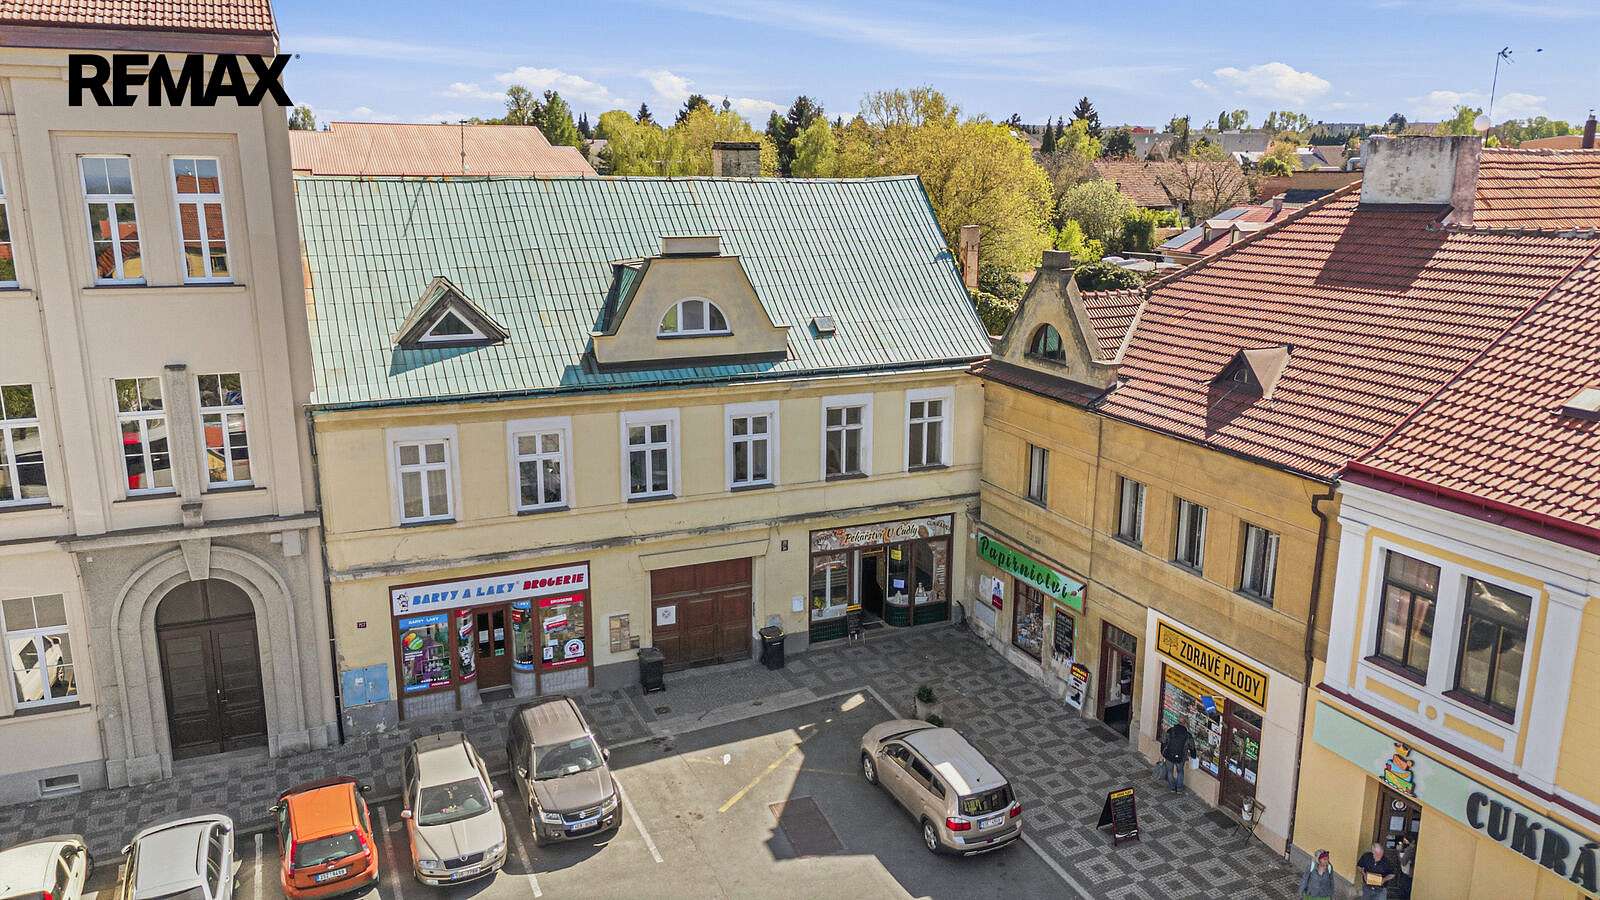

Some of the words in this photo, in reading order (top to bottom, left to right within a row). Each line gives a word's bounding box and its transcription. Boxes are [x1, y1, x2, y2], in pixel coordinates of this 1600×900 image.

[845, 530, 883, 543] Pekařství
[412, 590, 459, 606] BARVY
[462, 588, 471, 599] A
[476, 583, 515, 598] LAKY
[523, 573, 585, 590] DROGERIE
[1180, 640, 1222, 677] ZDRAVÉ
[1223, 663, 1260, 697] PLODY
[1466, 792, 1600, 893] CUKRÁ
